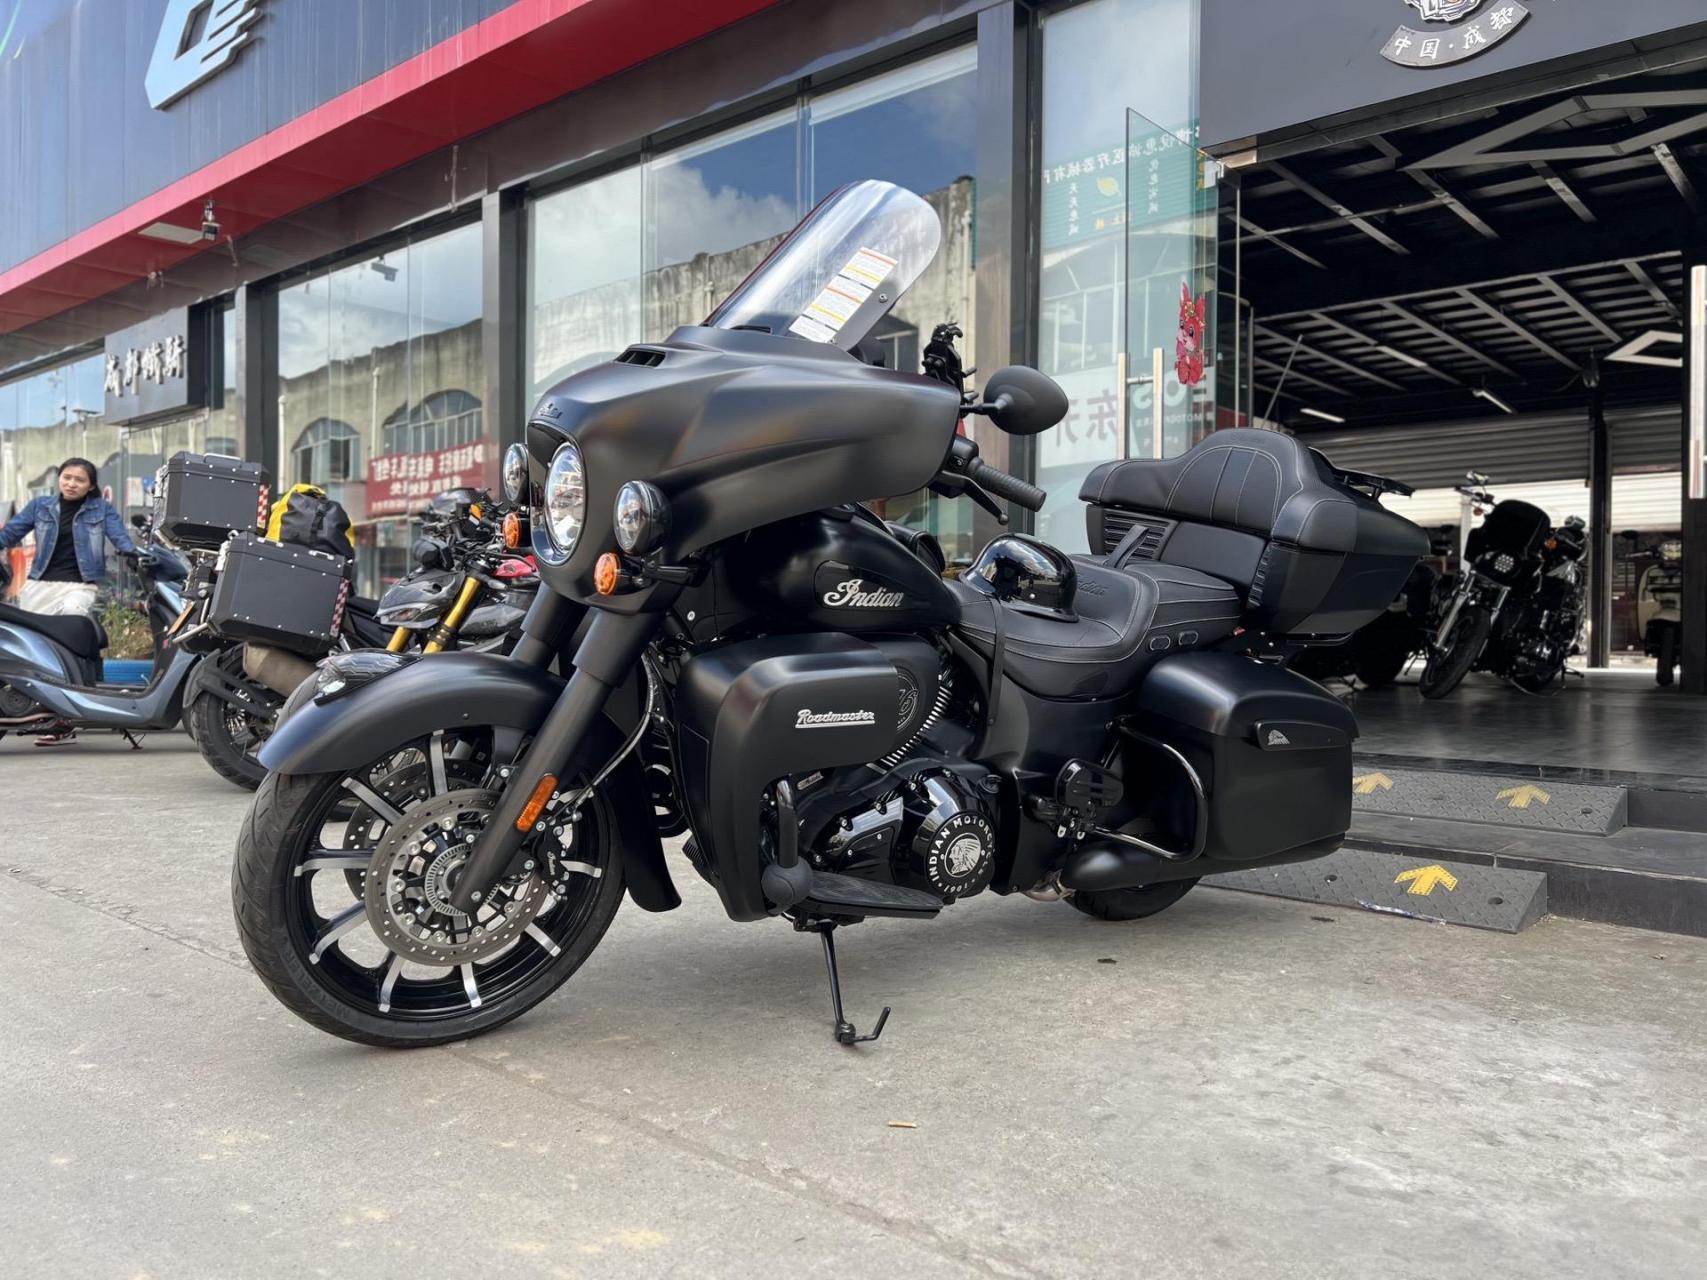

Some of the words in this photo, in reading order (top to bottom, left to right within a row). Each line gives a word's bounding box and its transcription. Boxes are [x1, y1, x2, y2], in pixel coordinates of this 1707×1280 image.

[1395, 7, 1514, 60] 中国·成都
[823, 578, 905, 607] Indian
[796, 709, 875, 727] Roadmaster
[928, 827, 951, 882] INDIAN
[952, 815, 993, 875] MOTORCYCLE
